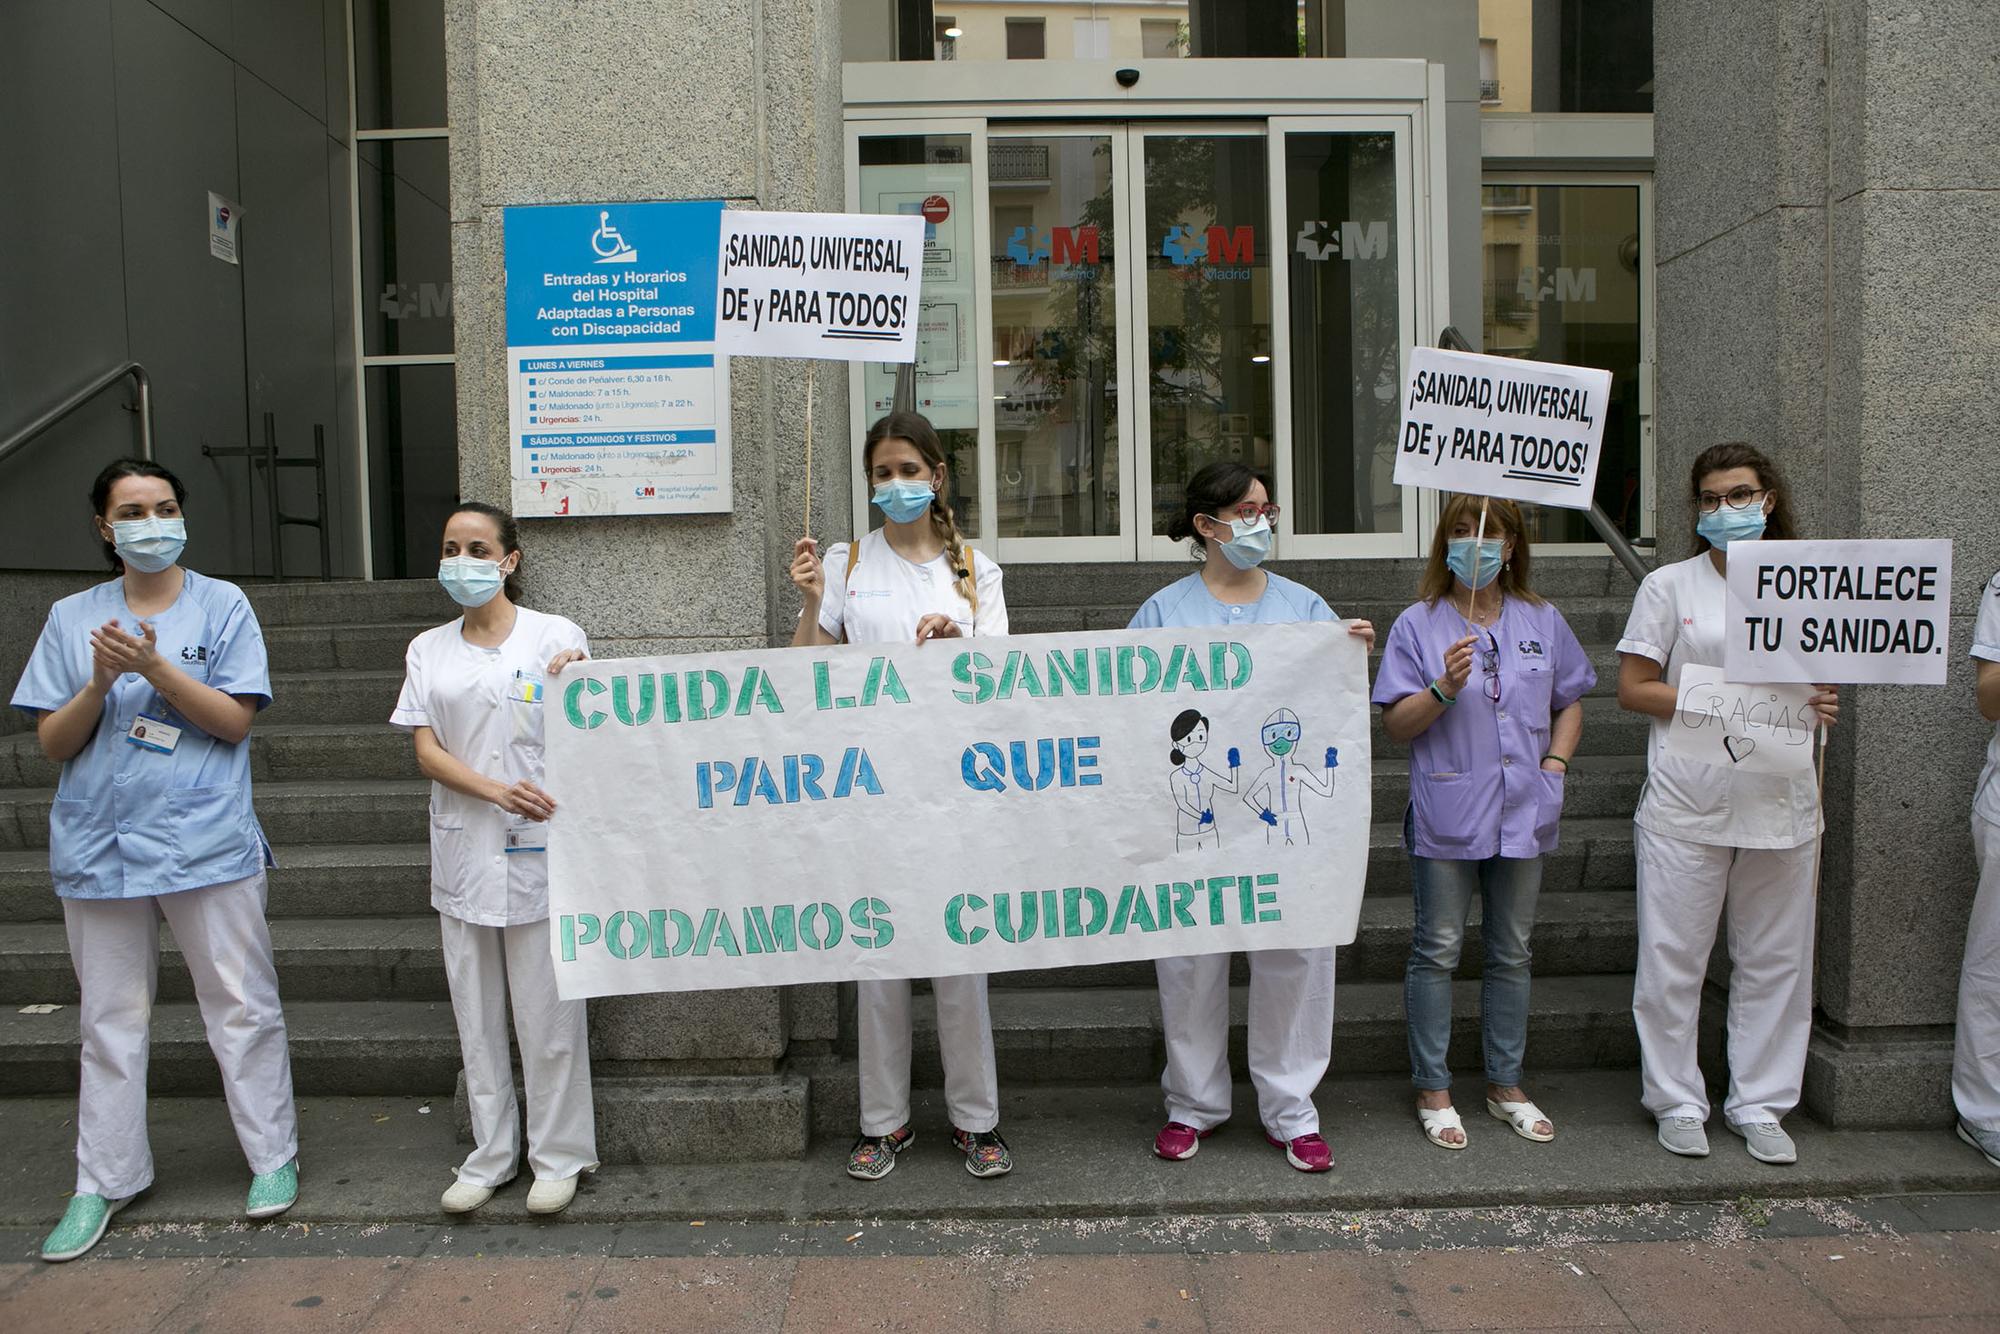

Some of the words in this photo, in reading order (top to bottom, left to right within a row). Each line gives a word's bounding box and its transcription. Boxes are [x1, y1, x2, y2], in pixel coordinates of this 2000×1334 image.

[1207, 225, 1255, 264] M
[1341, 221, 1389, 260] M
[724, 234, 806, 276] ¡SANIDAD,
[810, 236, 909, 281] UNIVERSAL,
[543, 273, 608, 286] Entradas
[612, 275, 620, 287] y
[624, 270, 687, 284] Horarios
[572, 289, 595, 302] del
[598, 288, 659, 303] Hospital
[537, 307, 613, 322] Adaptadas
[616, 308, 625, 318] a
[628, 304, 695, 317] Personas
[722, 287, 749, 321] DE
[753, 299, 764, 332] y
[768, 288, 822, 324] PARA
[826, 291, 908, 329] TODOS!
[552, 325, 579, 336] con
[582, 321, 681, 337] Discapacidad
[528, 361, 557, 370] LUNES
[559, 361, 565, 369] A
[567, 360, 605, 369] VIERNES
[539, 377, 547, 385] c/
[548, 377, 575, 385] Conde
[577, 376, 587, 384] de
[589, 375, 625, 385] Peñalver:
[539, 390, 547, 398] c/
[549, 389, 596, 398] Maldonado:
[1410, 370, 1493, 418] ¡SANIDAD,
[1497, 380, 1593, 430] UNIVERSAL,
[539, 403, 547, 411] c/
[549, 402, 594, 411] Maldonado
[539, 415, 581, 424] Urgencias:
[530, 436, 575, 446] SÁBADOS,
[576, 435, 625, 444] DOMINGOS
[627, 434, 633, 442] Y
[634, 434, 677, 443] FESTIVOS
[1403, 421, 1433, 455] DE
[1434, 434, 1448, 466] y
[1450, 427, 1505, 464] PARA
[1510, 434, 1589, 475] TODOS!
[541, 453, 549, 461] c/
[550, 452, 595, 460] Maldonado
[541, 466, 582, 475] Urgencias:
[596, 464, 603, 472] h.
[644, 487, 655, 496] M
[1757, 565, 1937, 601] FORTALECE
[1745, 617, 1783, 651] TU
[1800, 618, 1942, 655] SANIDAD.
[563, 666, 784, 730] CUIDA
[812, 656, 911, 710] LA
[951, 641, 1253, 704] SANIDAD
[696, 747, 885, 809] PARA
[960, 735, 1103, 793] QUE
[559, 896, 895, 962] PODAMOS
[943, 872, 1282, 945] CUIDARTE
